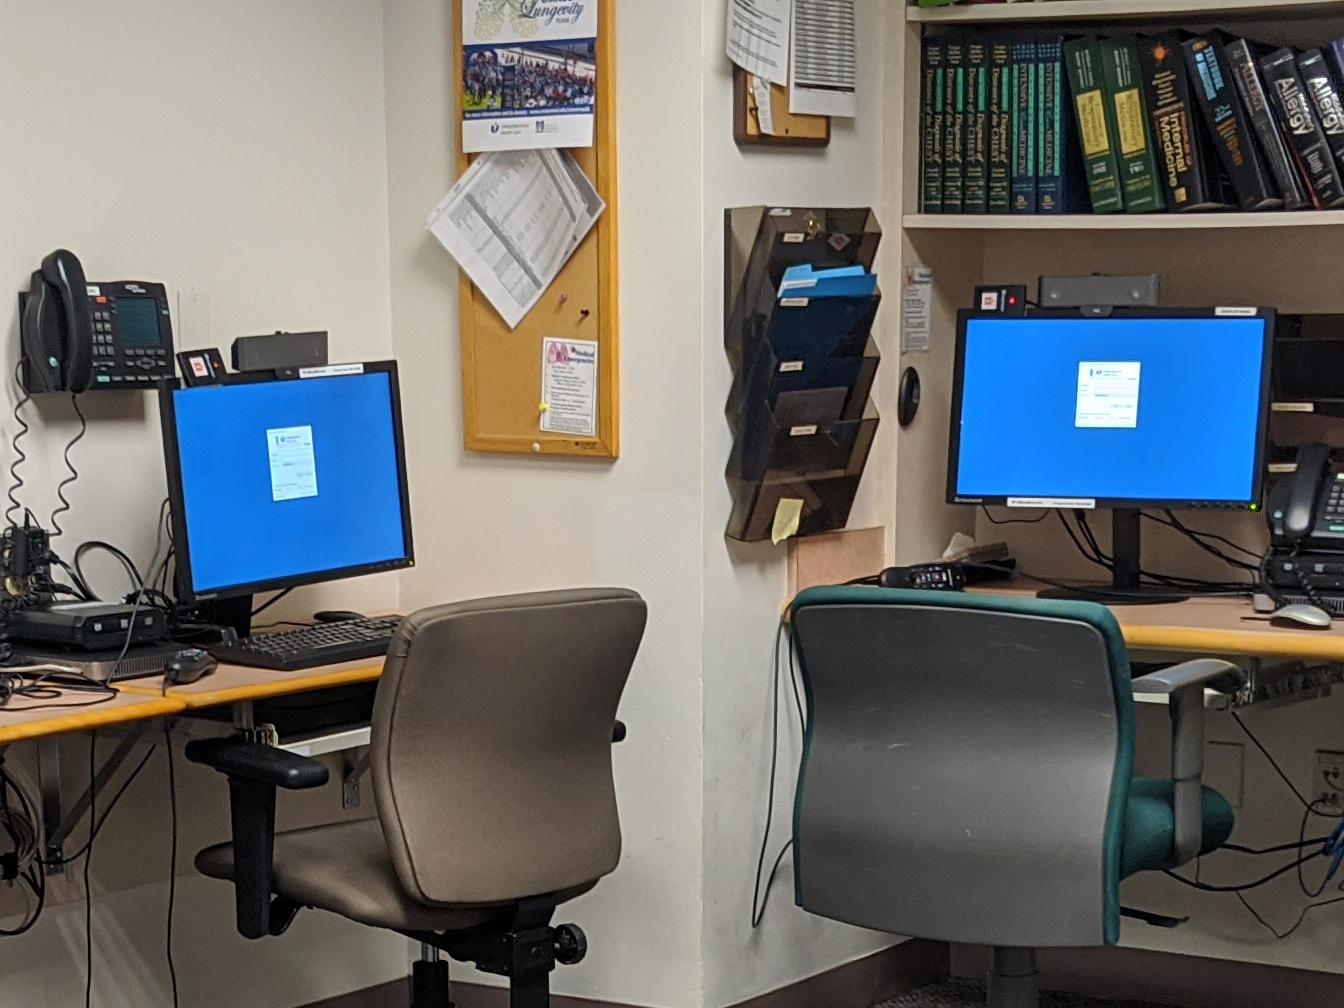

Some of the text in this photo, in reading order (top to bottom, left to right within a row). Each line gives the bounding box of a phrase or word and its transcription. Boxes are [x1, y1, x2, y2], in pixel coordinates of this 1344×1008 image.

[1277, 77, 1314, 135] Allergy
[1159, 116, 1178, 187] Medicine
[1170, 113, 1188, 173] Internal
